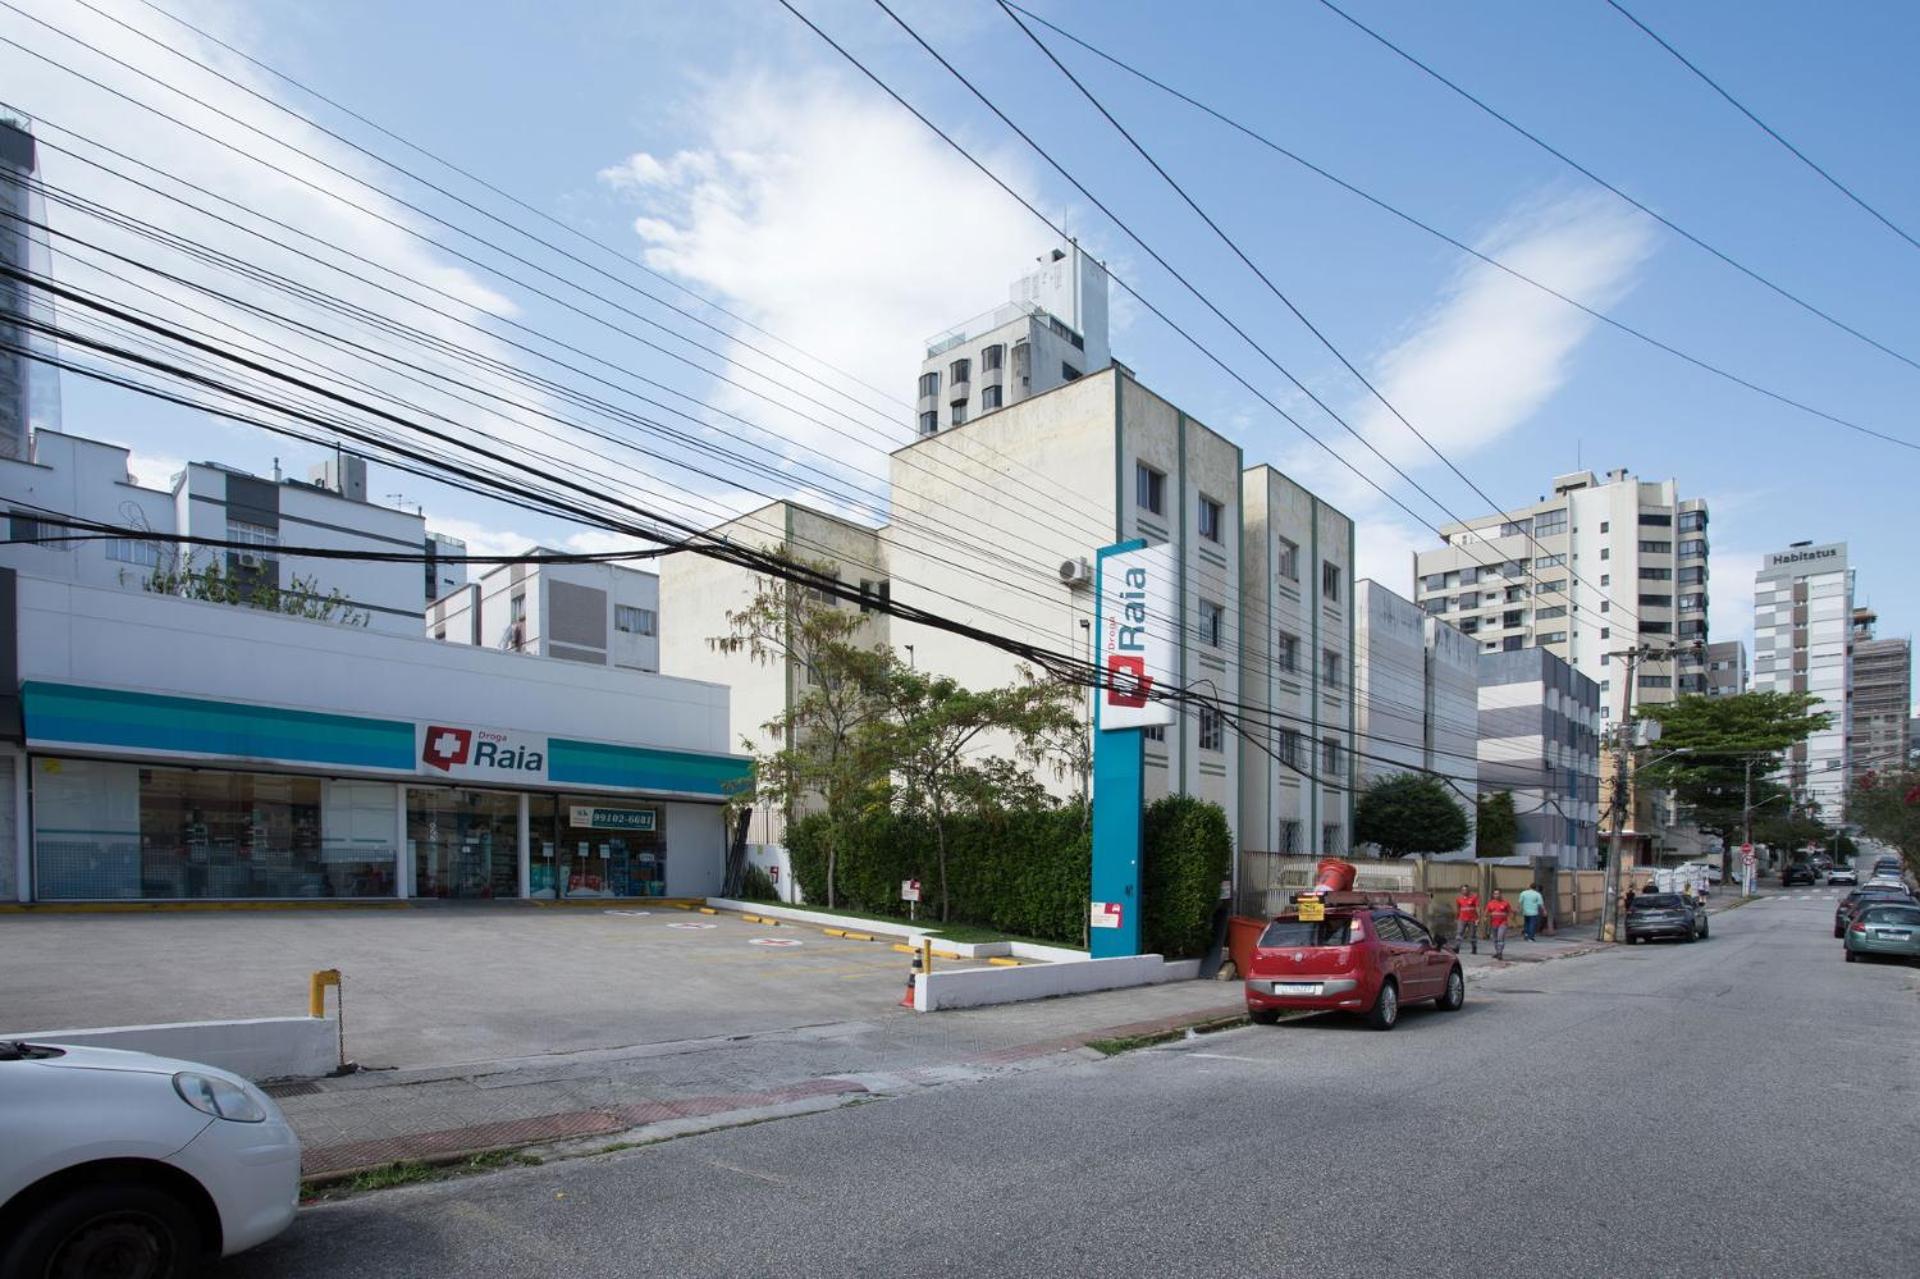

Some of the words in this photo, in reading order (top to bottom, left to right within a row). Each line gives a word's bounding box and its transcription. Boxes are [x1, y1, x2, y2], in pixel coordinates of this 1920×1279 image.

[1773, 548, 1837, 565] Habitatus
[1119, 568, 1146, 651] Raia
[478, 731, 508, 743] Droga
[474, 741, 544, 772] Raia
